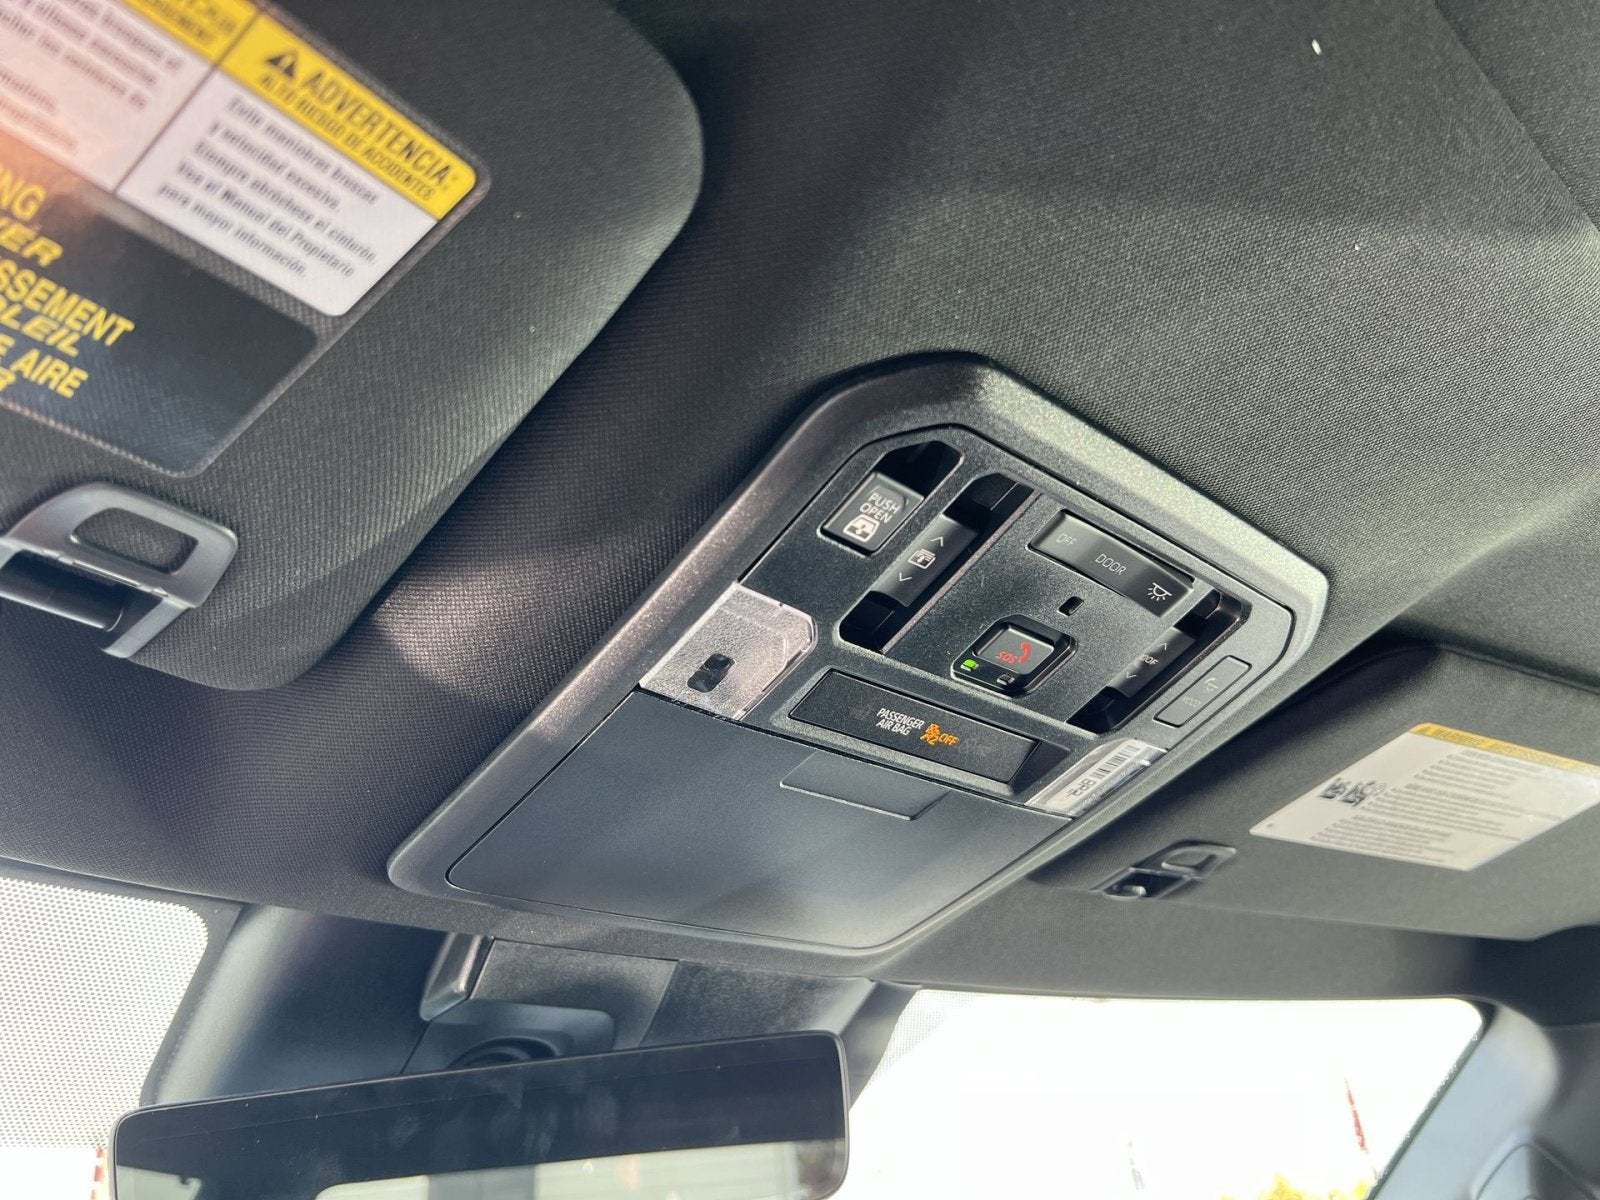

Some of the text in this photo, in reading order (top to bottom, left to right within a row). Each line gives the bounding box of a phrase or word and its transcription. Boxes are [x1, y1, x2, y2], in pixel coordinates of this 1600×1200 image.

[360, 144, 436, 202] ACCIDENTES
[329, 167, 381, 205] bruscas
[218, 188, 271, 224] Manual
[267, 218, 292, 238] del
[286, 231, 357, 279] Propietario
[312, 218, 330, 232] el
[9, 347, 89, 399] AIRE
[860, 502, 893, 524] OPEN
[868, 492, 901, 515] PUSH
[1056, 533, 1077, 546] OFF
[1095, 553, 1127, 576] DOOR
[995, 650, 1018, 664] SOS
[875, 718, 912, 736] AIR BAG
[876, 708, 925, 730] PASSENGER
[939, 733, 959, 746] OFF
